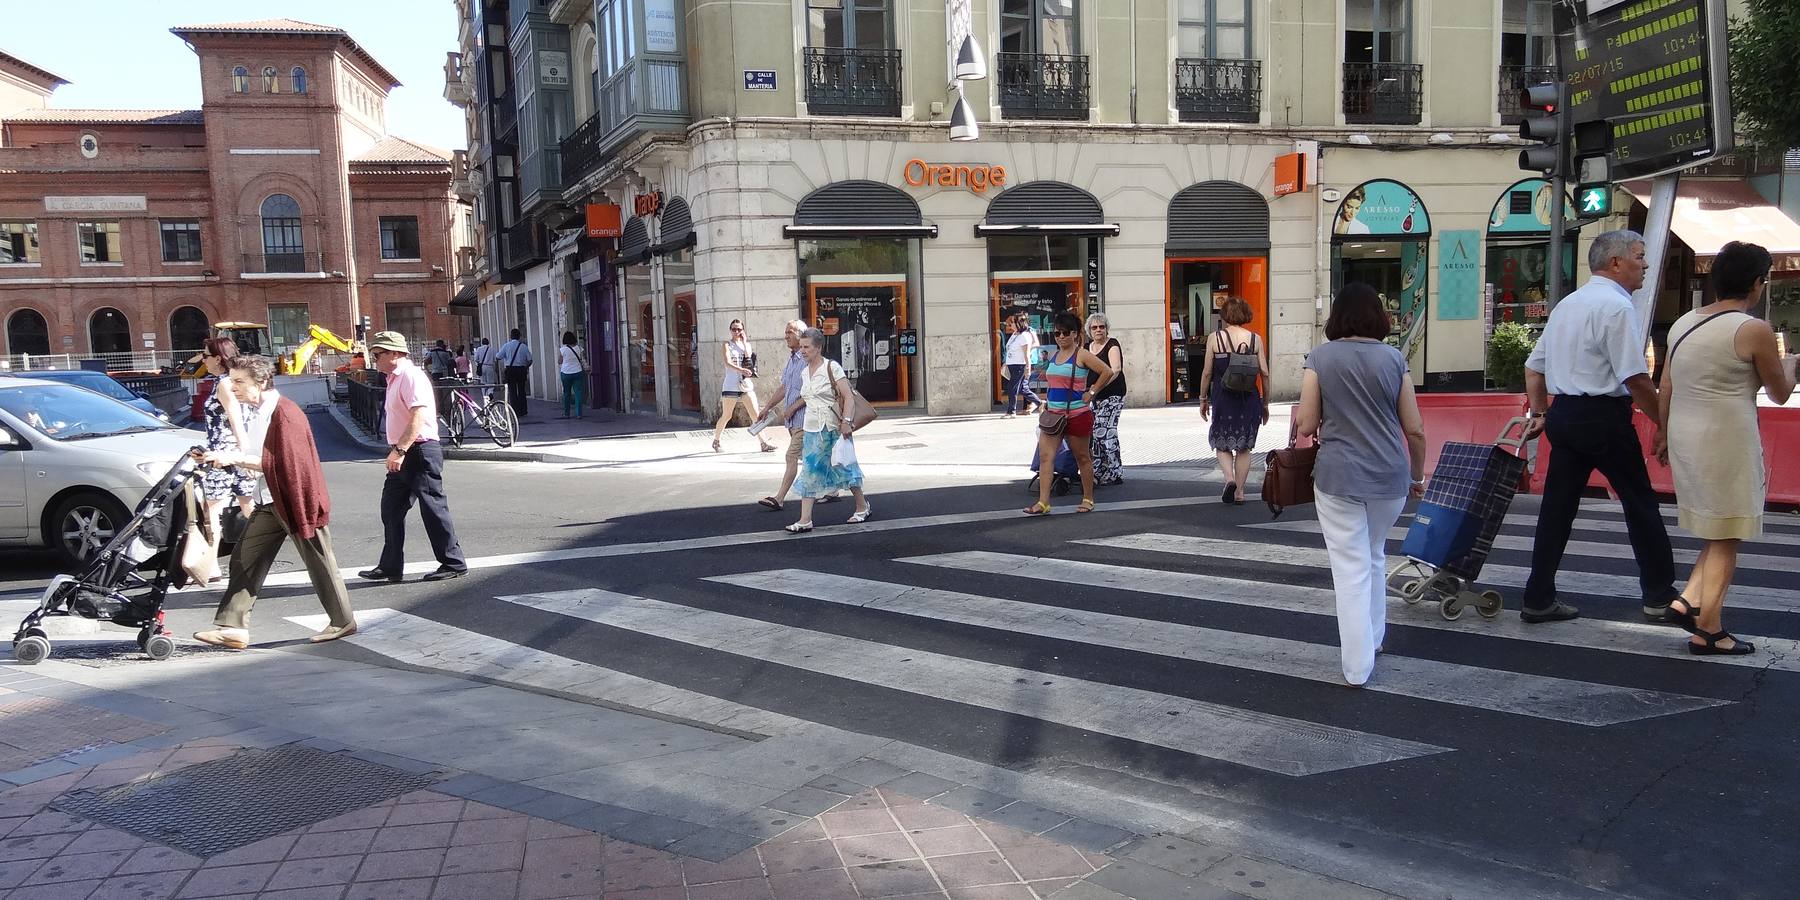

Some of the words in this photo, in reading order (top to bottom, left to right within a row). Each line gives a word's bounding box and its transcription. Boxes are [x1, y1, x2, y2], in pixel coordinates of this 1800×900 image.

[1567, 57, 1624, 86] 22/07/15
[904, 158, 1007, 193] Orange
[1275, 181, 1294, 193] orange
[635, 191, 659, 217] Orange
[1364, 206, 1401, 214] ARESSO
[591, 228, 619, 237] orange
